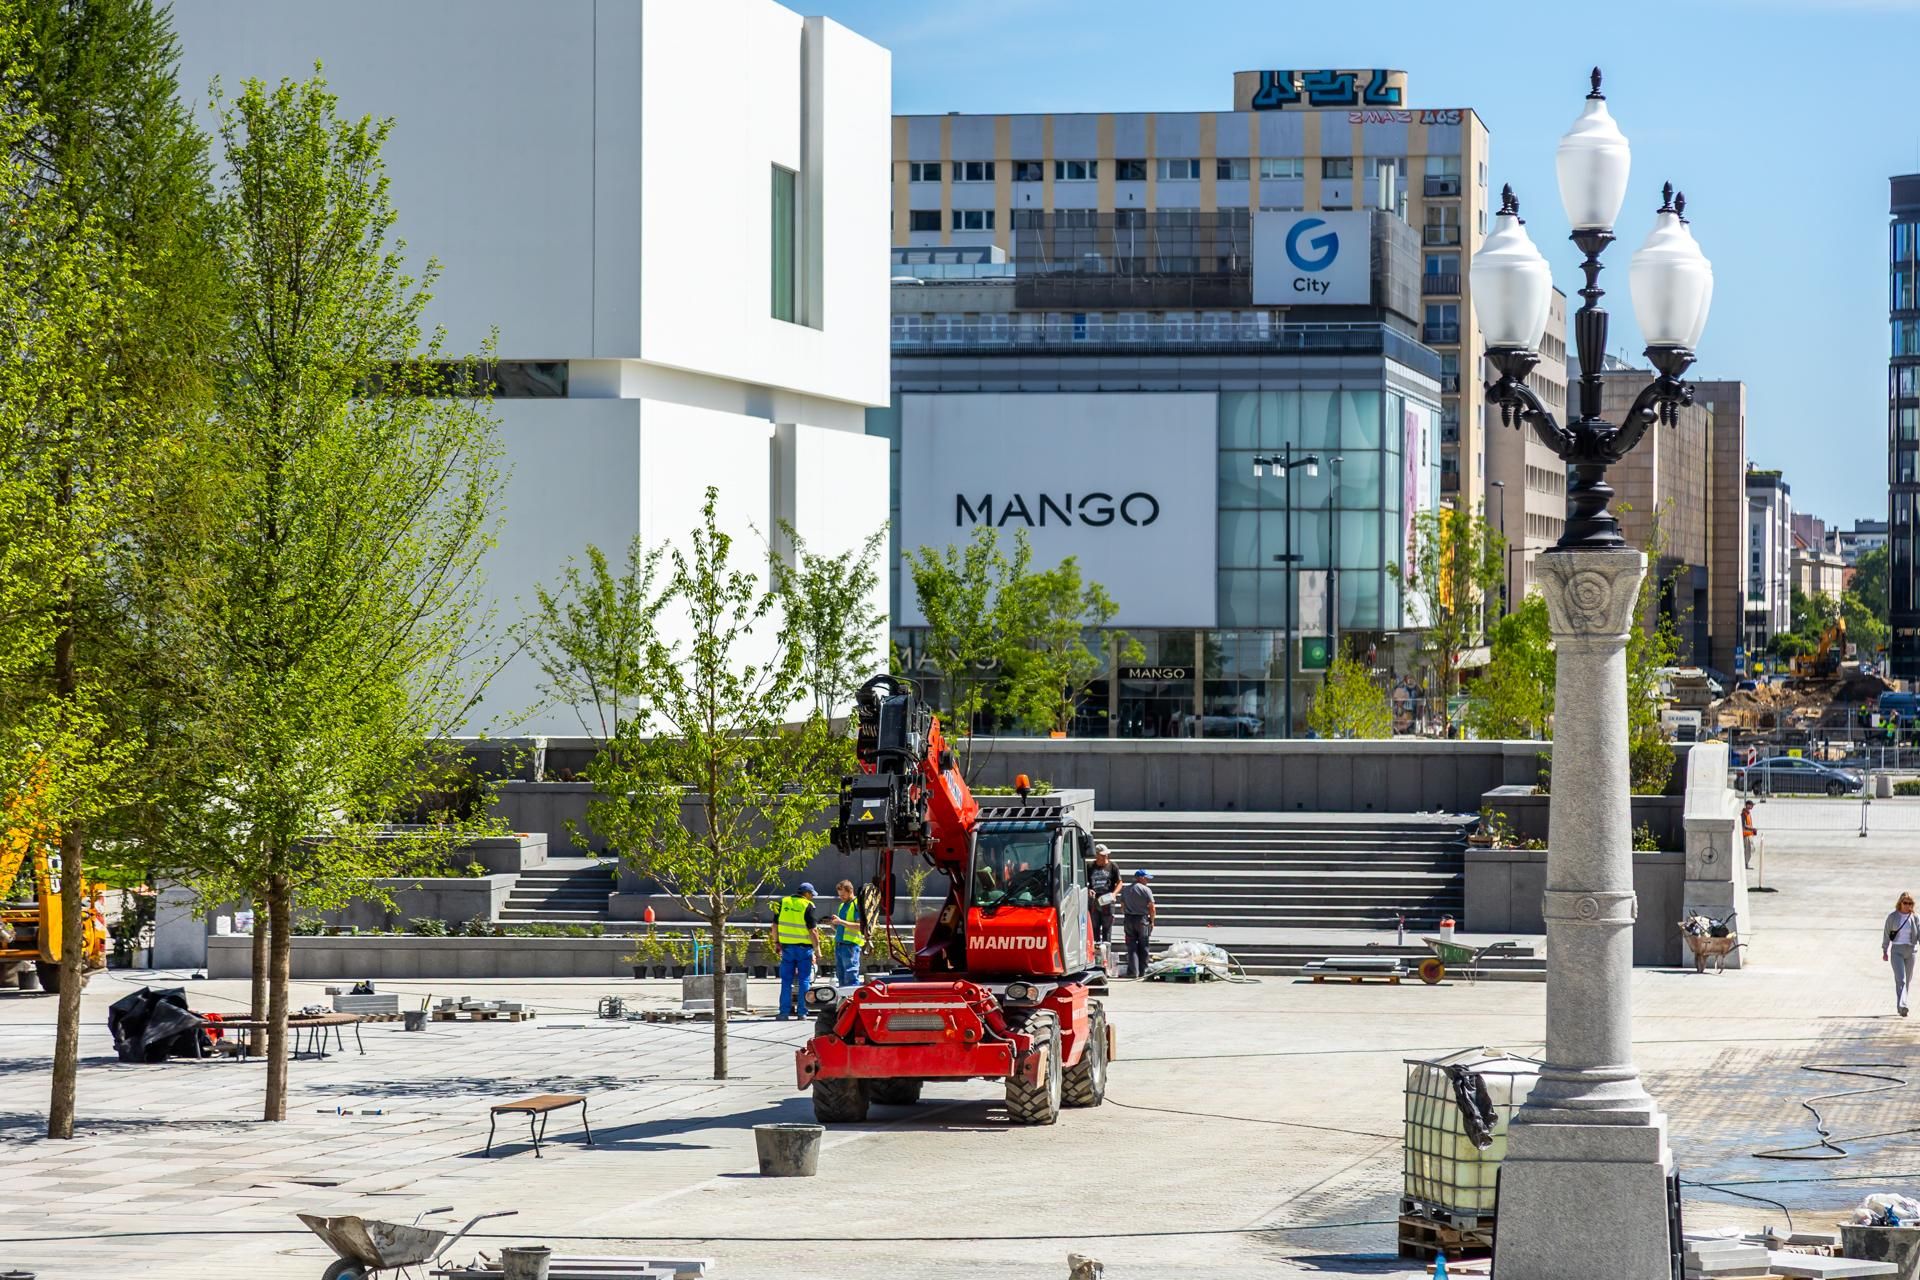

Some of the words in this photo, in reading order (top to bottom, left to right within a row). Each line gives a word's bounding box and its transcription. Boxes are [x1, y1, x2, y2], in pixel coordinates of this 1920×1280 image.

[1285, 218, 1339, 272] G
[1293, 277, 1330, 295] City
[956, 492, 1160, 527] MANGO
[1129, 668, 1186, 679] MANGO
[969, 936, 1048, 950] MANITOU
